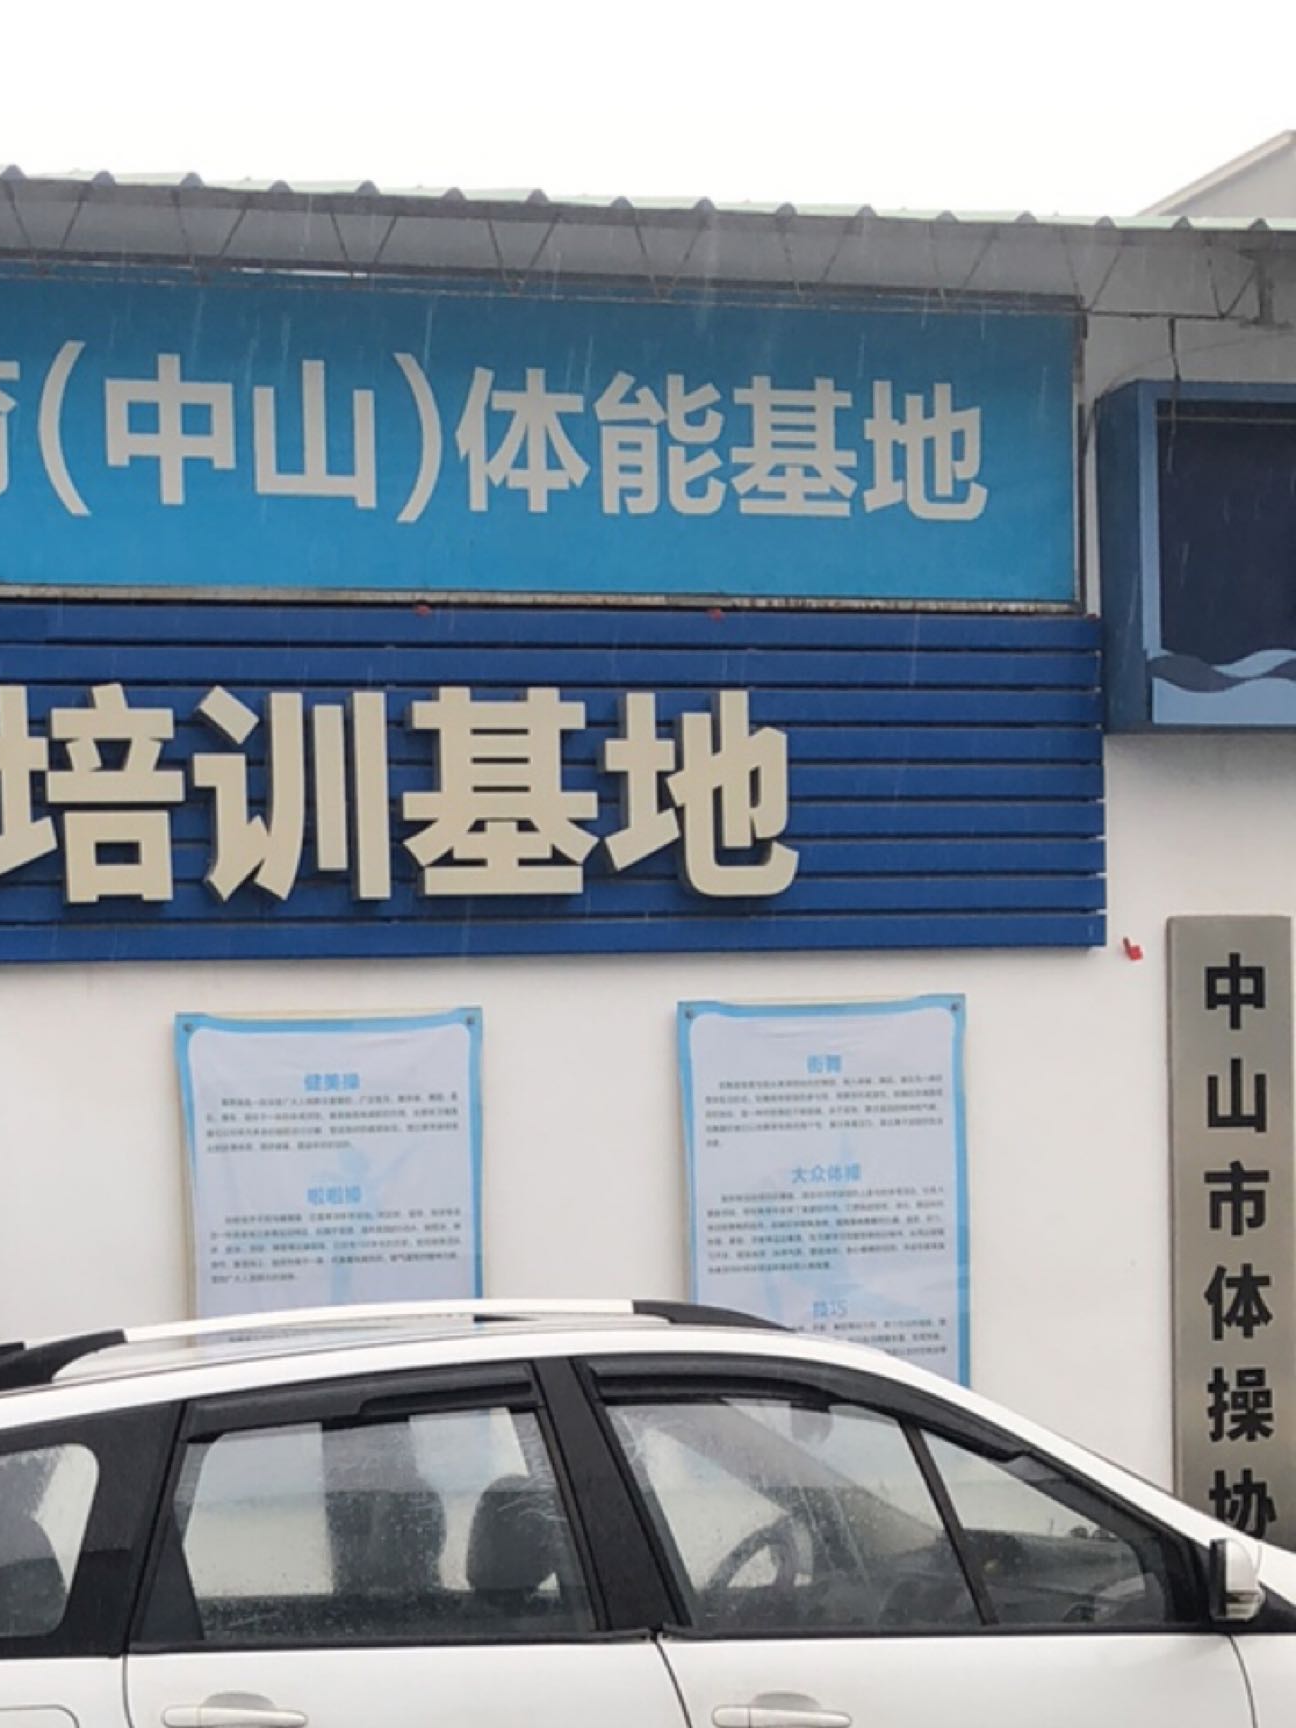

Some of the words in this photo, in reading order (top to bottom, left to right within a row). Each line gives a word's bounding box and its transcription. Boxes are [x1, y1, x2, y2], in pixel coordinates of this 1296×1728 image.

[1204, 952, 1276, 1539] 中山市体操协
